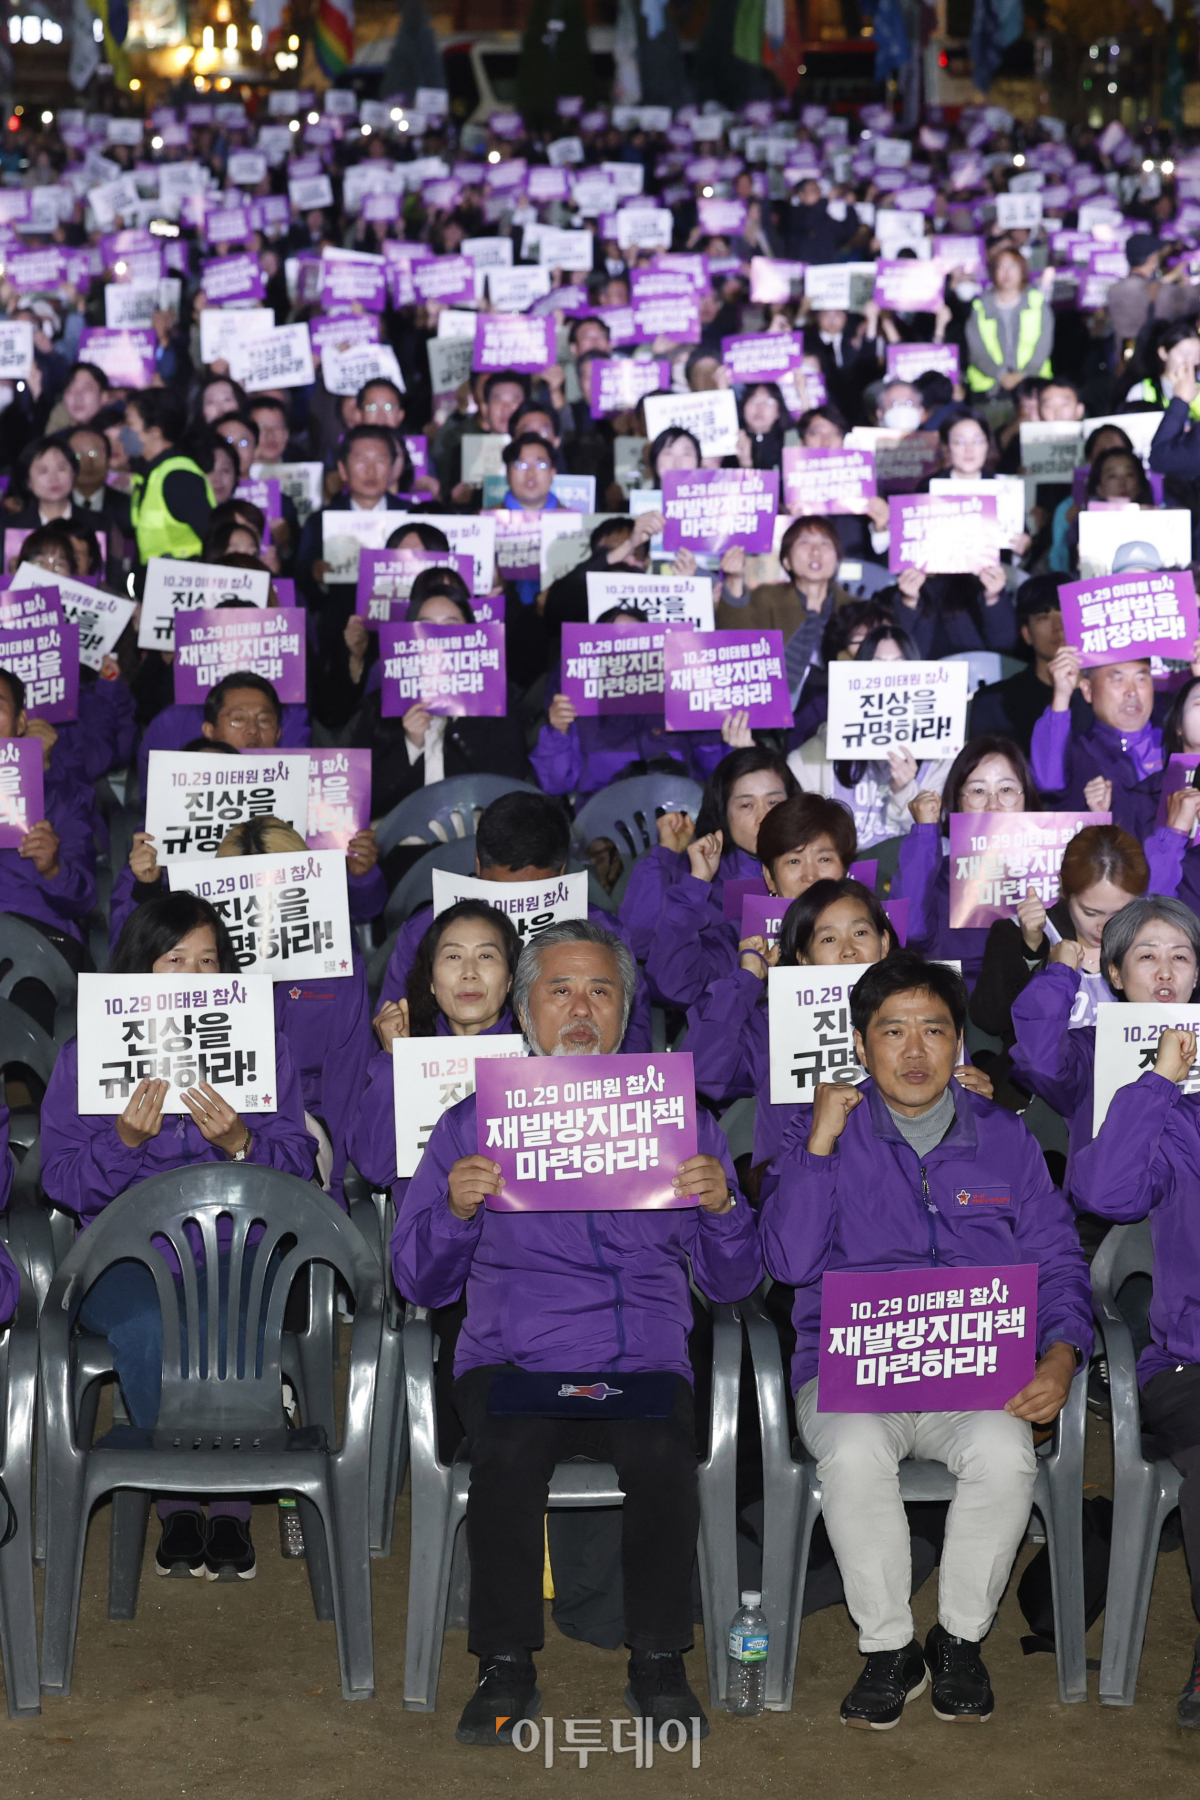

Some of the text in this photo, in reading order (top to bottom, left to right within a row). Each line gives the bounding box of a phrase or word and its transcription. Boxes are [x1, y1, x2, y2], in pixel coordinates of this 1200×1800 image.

[163, 575, 193, 588] 10.29
[605, 585, 635, 594] 10.29
[637, 584, 670, 594] 이태원
[1077, 574, 1175, 606] 10.29 이태원 참사
[1080, 592, 1179, 627] 특별법을
[37, 628, 61, 652] 참사
[190, 626, 223, 642] 10.29
[224, 621, 262, 638] 이태원
[263, 614, 288, 634] 참사
[393, 629, 488, 655] 10.29 이태원 참사
[1080, 614, 1187, 654] 제정하라!
[178, 633, 300, 666] 재발방지대책
[578, 639, 612, 656] 10.29
[613, 635, 650, 653] 이태원
[682, 637, 771, 666] 10.29 이태원 참사
[384, 649, 500, 679] 재발방지대책
[566, 651, 664, 680] 재발방지대
[670, 657, 783, 691] 재발방지대책
[848, 667, 949, 691] 10.29 이태원 참사
[399, 672, 484, 699] 마련하라!
[689, 682, 773, 712] 마련하라!
[859, 689, 937, 719] 진상을
[841, 716, 952, 748] 규명하라!
[172, 760, 290, 787] 10.29 이태원 참사
[321, 752, 350, 774] 참사
[184, 787, 276, 822] 진상을
[970, 834, 1011, 852] 10.29
[1013, 827, 1058, 846] 이태원
[195, 856, 322, 898] 10.29 이태원 참사
[955, 848, 1067, 881] 재발방지
[214, 887, 310, 933] 진상을
[493, 895, 540, 915] 이태원
[543, 881, 569, 908] 참사
[104, 979, 248, 1016] 10.29 이태원 참사
[795, 985, 842, 1007] 10.29
[121, 1011, 232, 1057] 진상을
[98, 1050, 257, 1100] 규명하라!
[421, 1057, 468, 1079] 10.29
[504, 1085, 559, 1110] 10.29
[563, 1077, 622, 1103] 이태원
[625, 1064, 666, 1095] 참사
[485, 1095, 686, 1150] 재발방지대책
[515, 1137, 660, 1182] 마련하라!
[849, 1277, 1009, 1320] 10.29 이태원 참사
[827, 1305, 1027, 1357] 재발방지대책
[855, 1344, 998, 1387] 마련하라!
